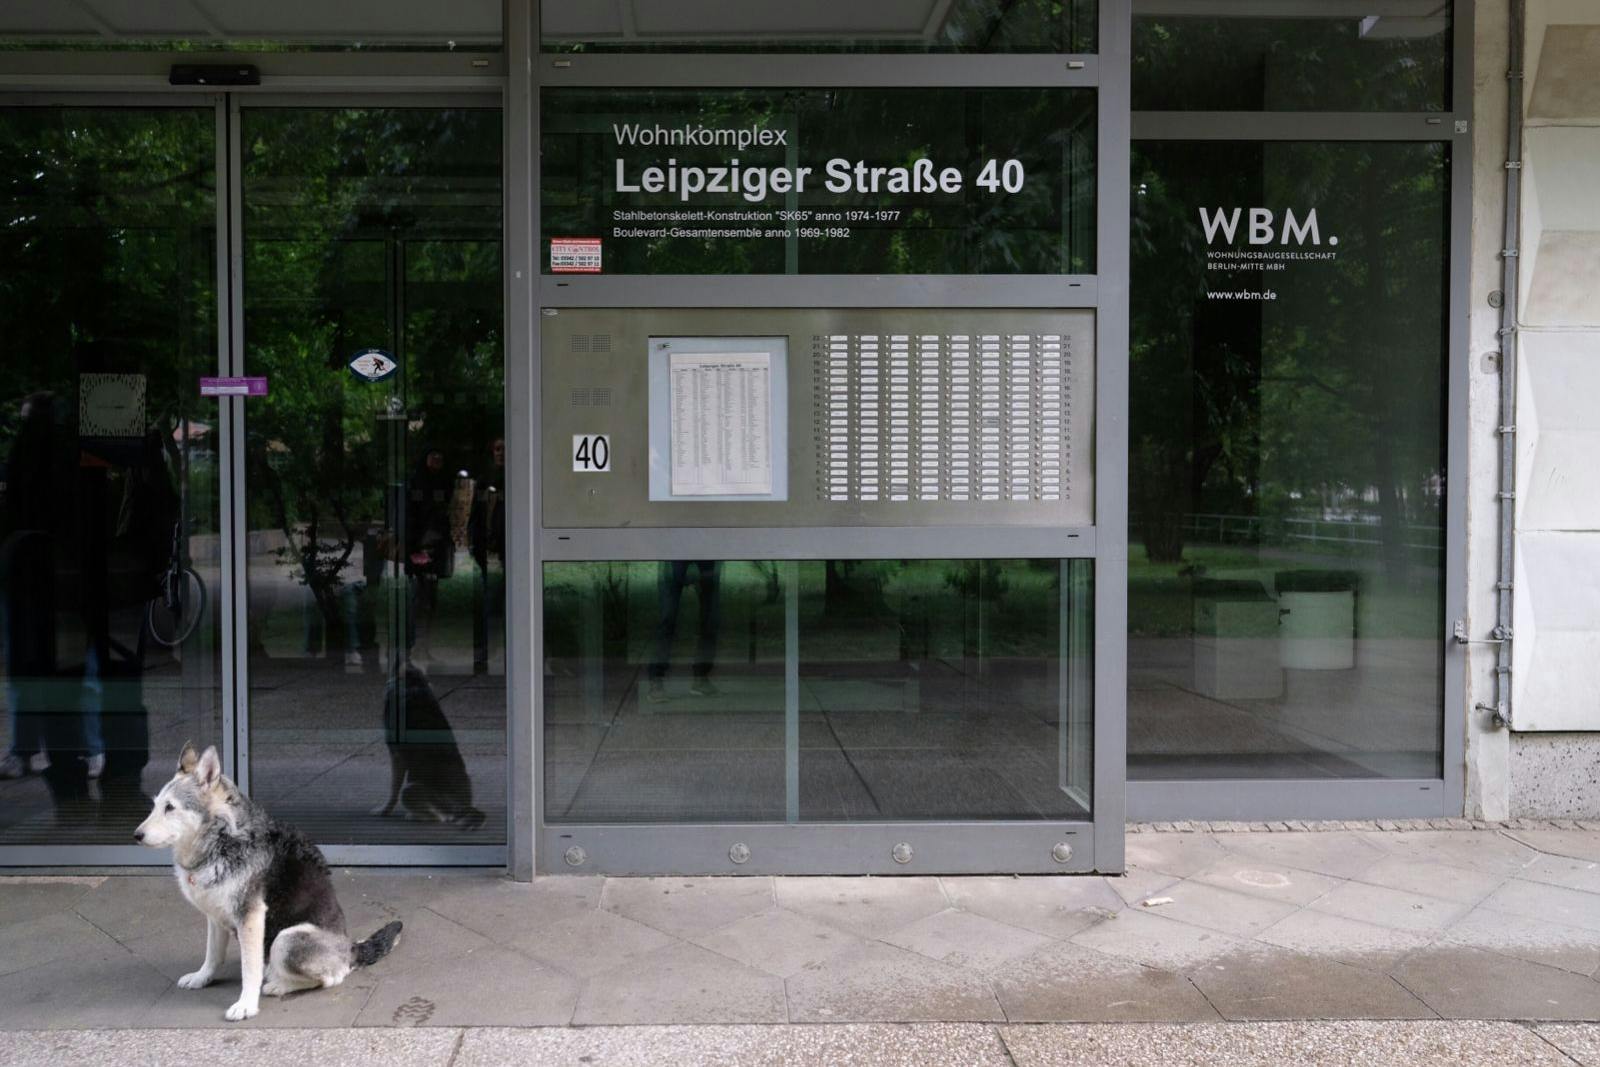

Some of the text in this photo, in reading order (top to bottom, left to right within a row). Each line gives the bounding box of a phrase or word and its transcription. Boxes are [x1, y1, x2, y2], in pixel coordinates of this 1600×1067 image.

[613, 123, 788, 151] Wohnkomplex
[615, 158, 1025, 202] Leipziger Straße 40
[612, 210, 901, 222] Stahlbetonskelett-Konstruktion "SK65" anno 1974-1977
[612, 227, 850, 239] Boulevard-Gesamtensemble anno 1969-1982
[1207, 251, 1337, 260] WOHNUNGSBAUGESELLSCHAFT
[1207, 262, 1285, 271] BERLIN-MITTE MBH
[1206, 288, 1277, 300] www.wbm.de
[575, 435, 609, 470] 40
